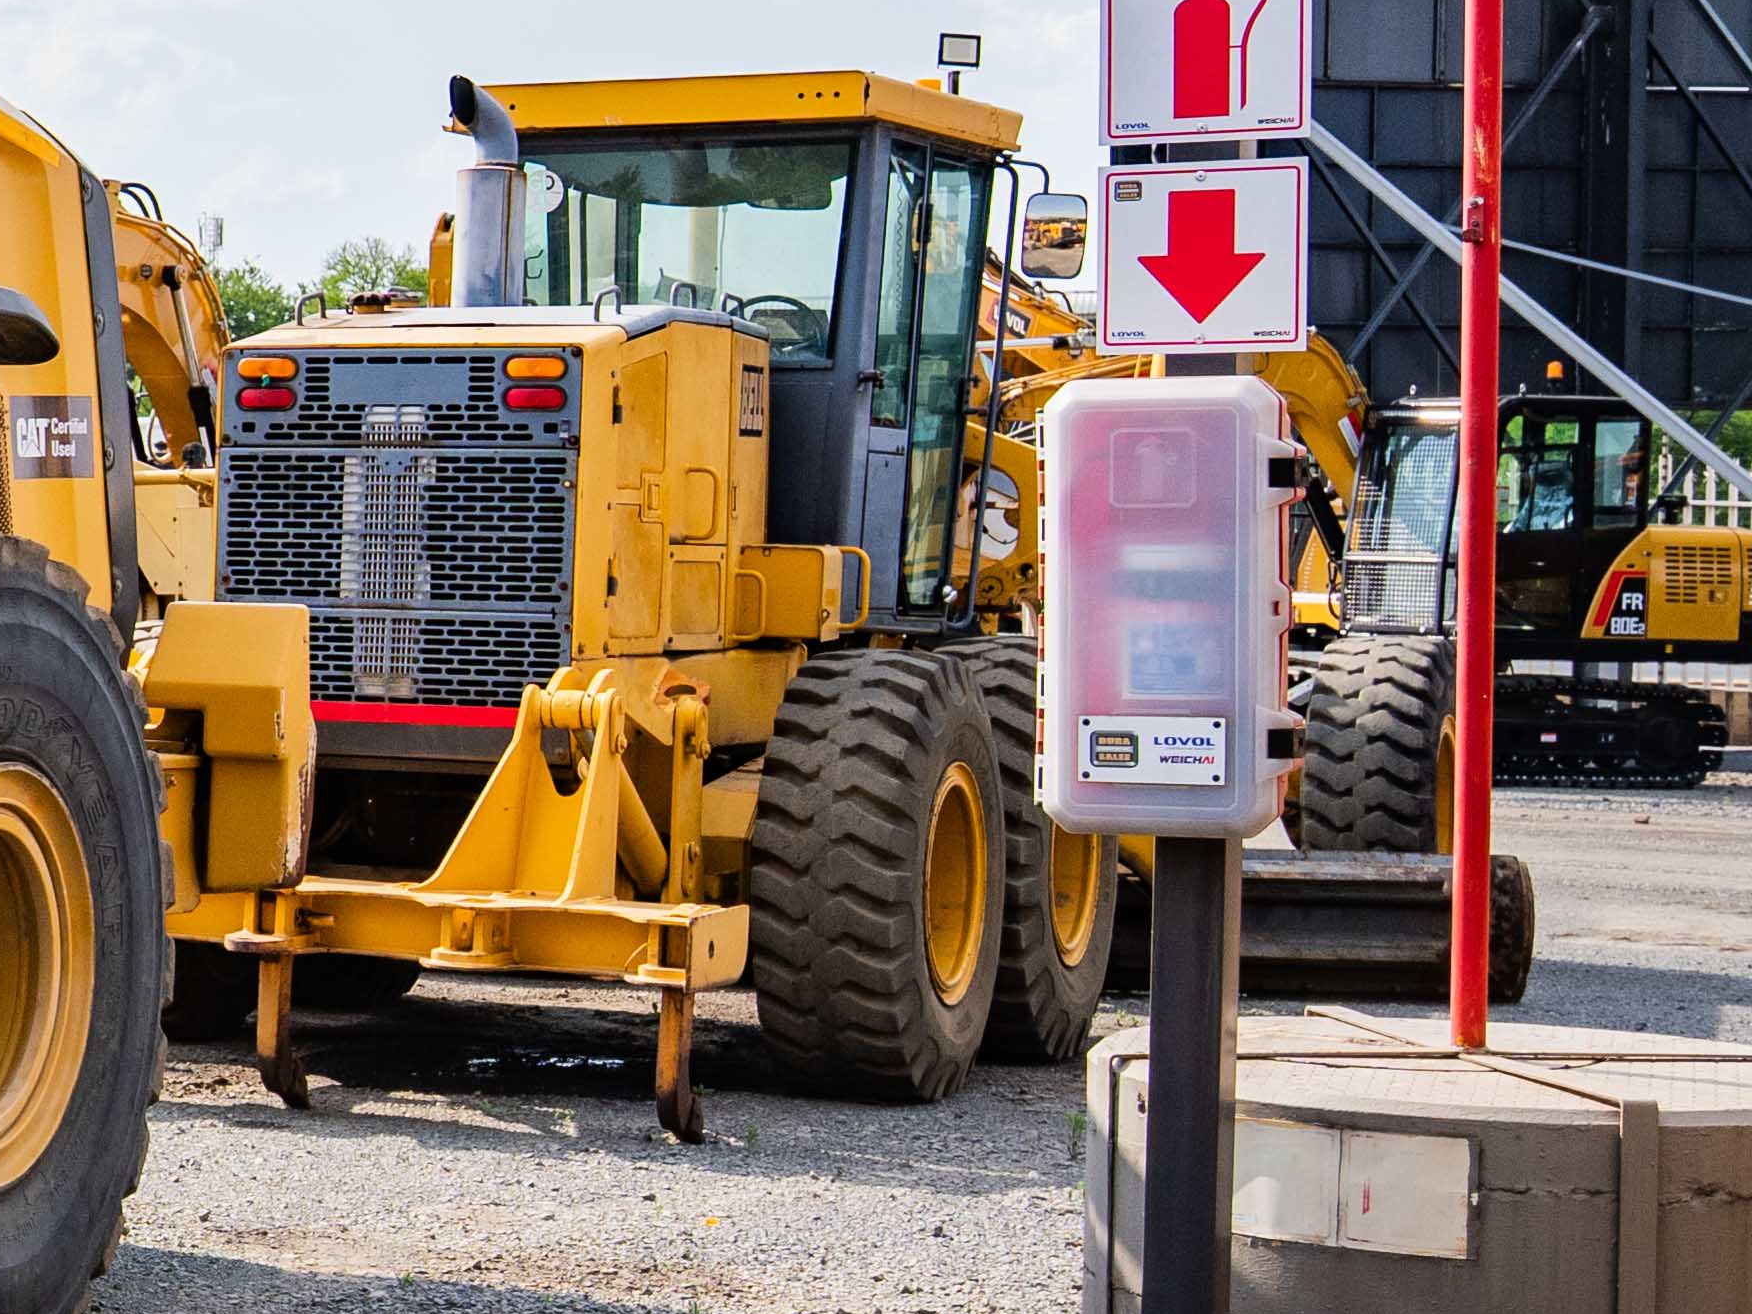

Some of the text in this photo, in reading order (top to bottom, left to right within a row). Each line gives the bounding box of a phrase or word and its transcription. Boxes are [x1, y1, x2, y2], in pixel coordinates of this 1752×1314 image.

[1115, 121, 1151, 130] LOVOL
[1257, 116, 1295, 125] WEICHAI
[993, 302, 1027, 336] LVOL
[1111, 330, 1146, 338] LOVOL
[16, 417, 88, 458] CAT Certified
[51, 440, 76, 457] Used
[1622, 592, 1644, 611] FR
[1153, 736, 1216, 747] LOVOL
[1159, 755, 1215, 764] WEICHAI
